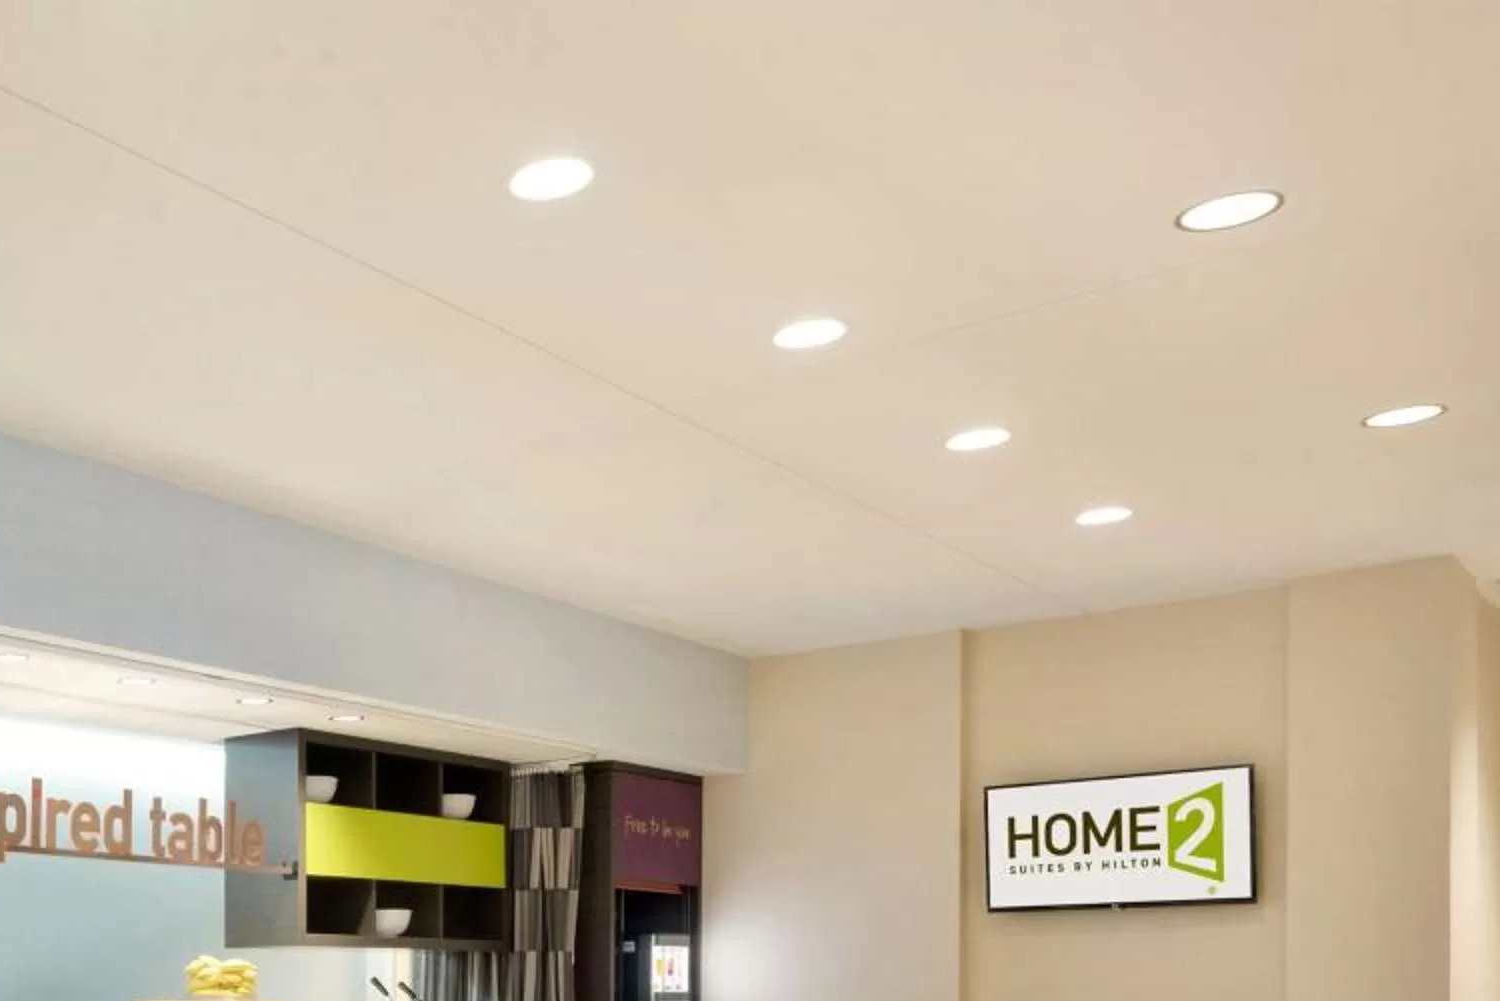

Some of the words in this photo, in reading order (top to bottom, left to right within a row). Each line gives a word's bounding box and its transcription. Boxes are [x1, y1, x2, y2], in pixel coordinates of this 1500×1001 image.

[149, 796, 265, 866] table
[1008, 805, 1161, 859] HOME
[1008, 862, 1066, 876] SUITES
[1074, 860, 1093, 872] BY
[1101, 856, 1162, 870] HILTON
